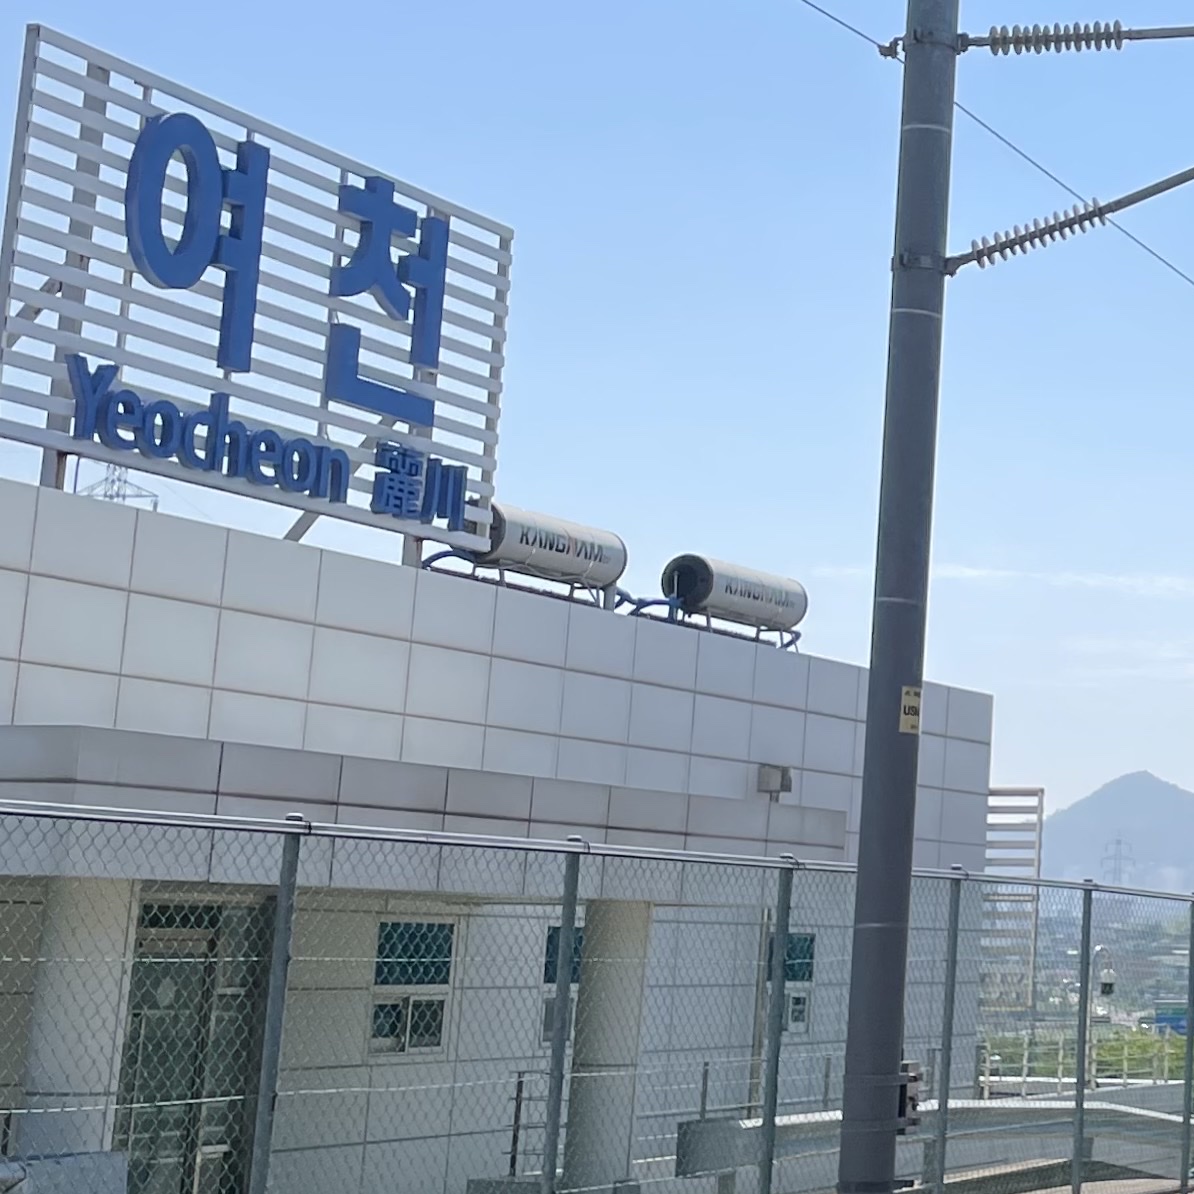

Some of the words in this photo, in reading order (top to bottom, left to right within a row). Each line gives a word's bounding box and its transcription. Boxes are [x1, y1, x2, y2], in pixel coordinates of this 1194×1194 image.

[124, 112, 451, 430] 여천
[64, 352, 350, 503] Yeocheon
[519, 526, 604, 564] KANGNAM
